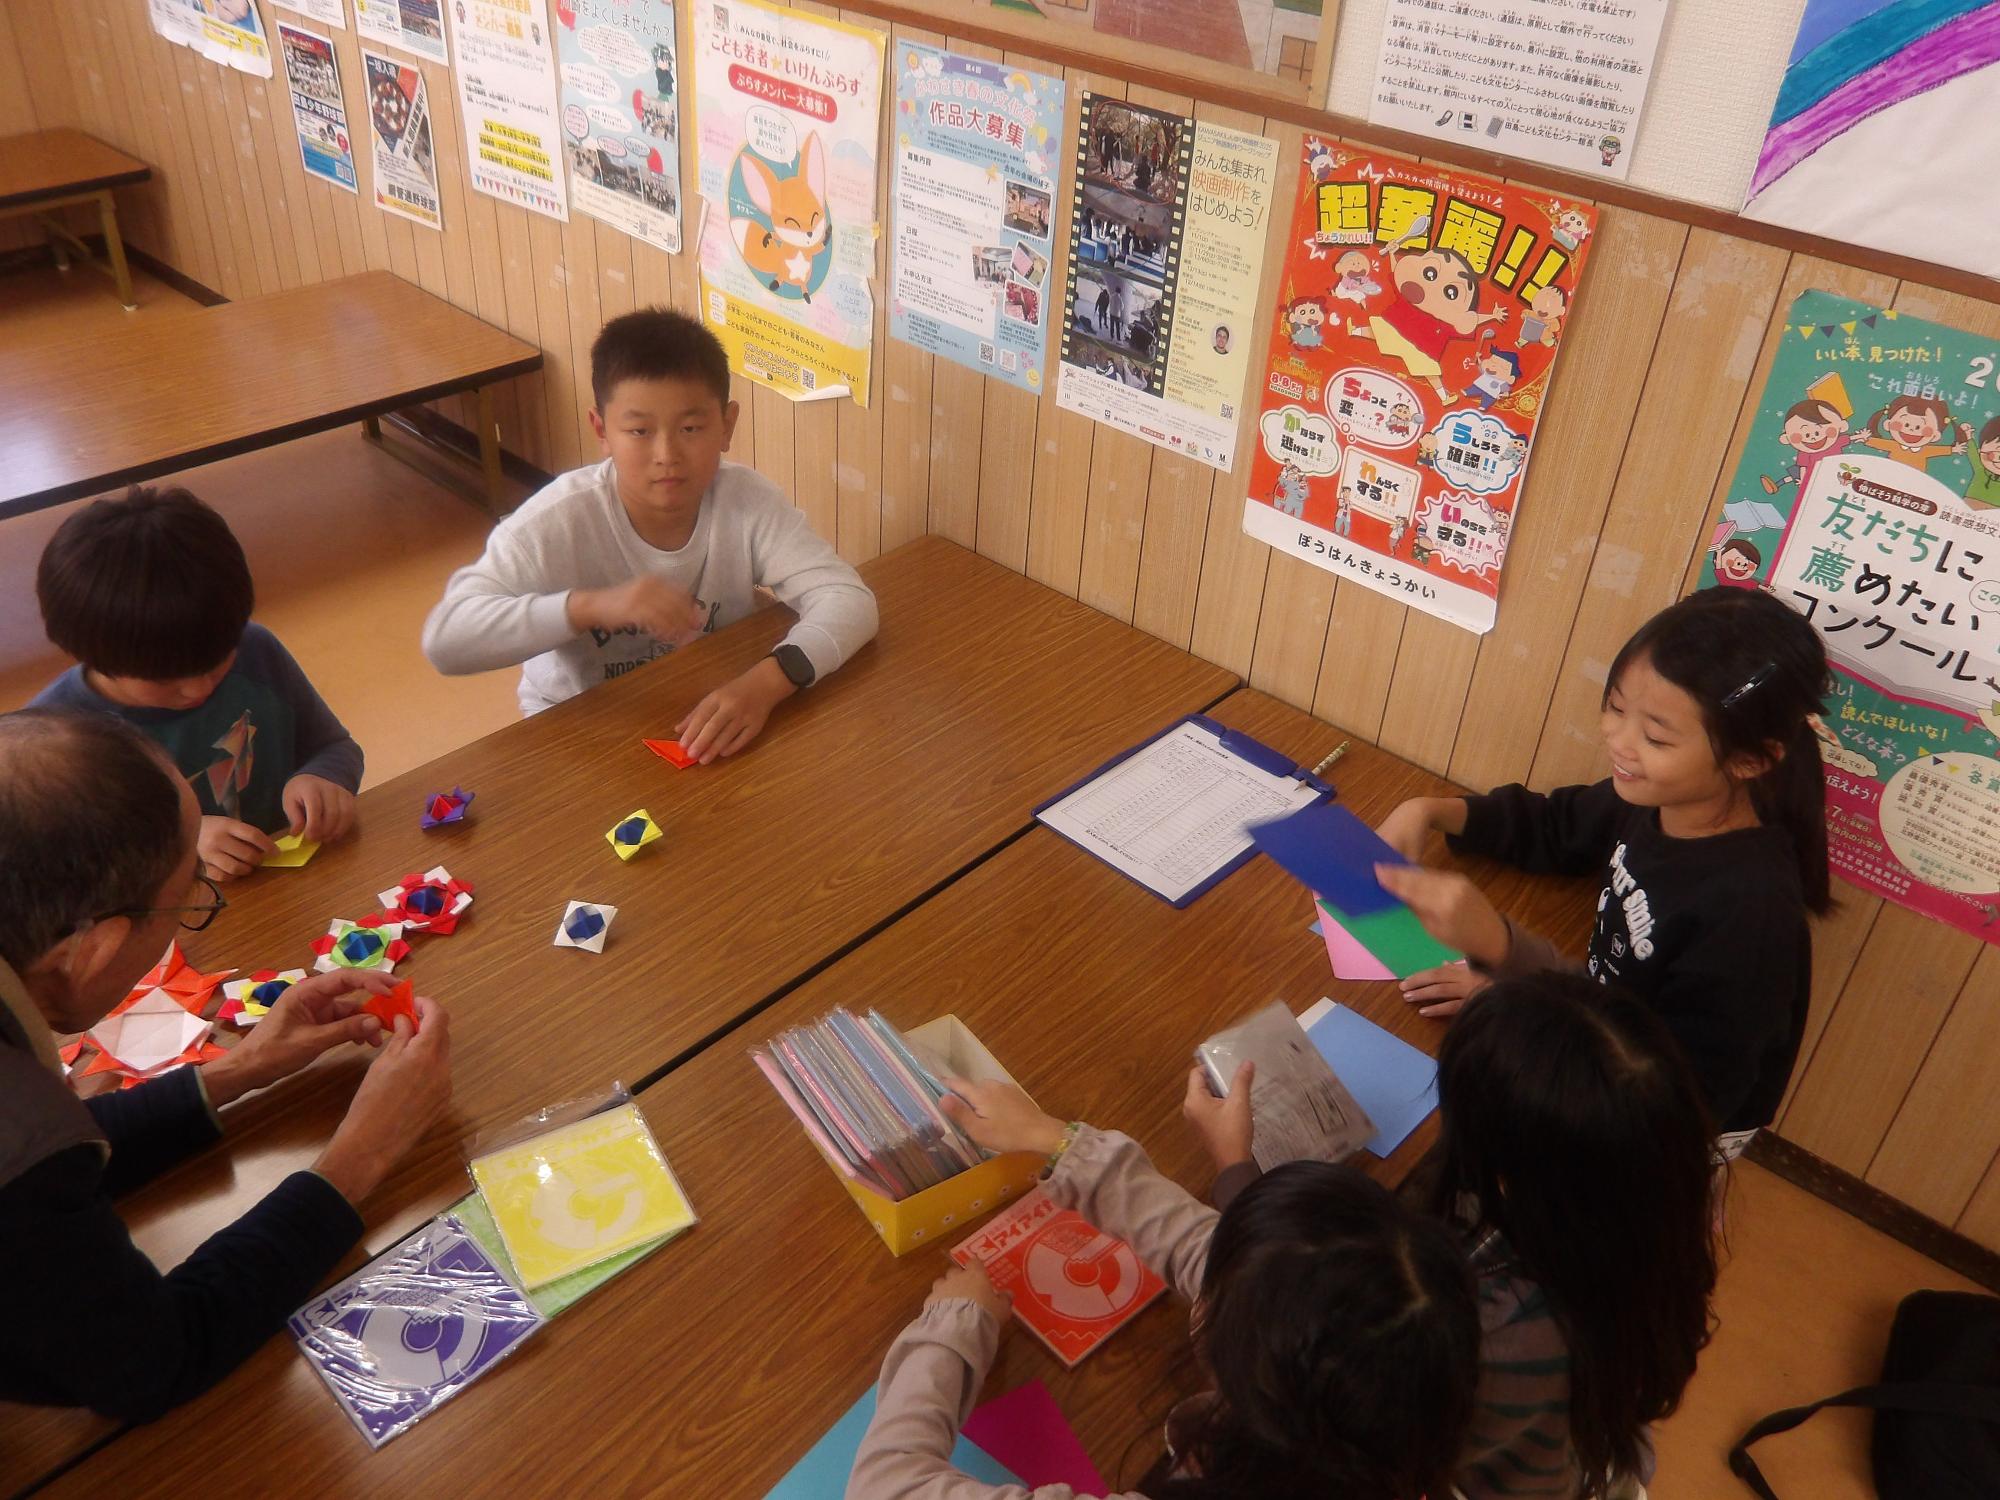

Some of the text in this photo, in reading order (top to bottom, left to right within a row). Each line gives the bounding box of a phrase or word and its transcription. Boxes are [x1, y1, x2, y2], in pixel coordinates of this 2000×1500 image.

[929, 100, 1026, 151] 作品大募集
[1191, 168, 1262, 206] 映画制作を
[1188, 191, 1265, 231] はじめよう！
[1815, 346, 1944, 363] いい本、見つけた！
[1342, 376, 1388, 409] ちょっと
[1868, 374, 1979, 410] これ面白いよ！
[1963, 356, 2000, 393] 2
[1452, 422, 1502, 455] うしろを
[1360, 460, 1401, 493] れんらく
[1440, 503, 1488, 536] いのちを
[1819, 492, 1984, 582] 友だちに
[1298, 531, 1437, 600] ぼうはんきょうかい
[1798, 544, 1980, 632] 薦めたい
[1792, 588, 1978, 683] コンクール
[1840, 703, 1948, 742] 読んでほしいな！
[1825, 774, 1879, 805] 伝えよう！
